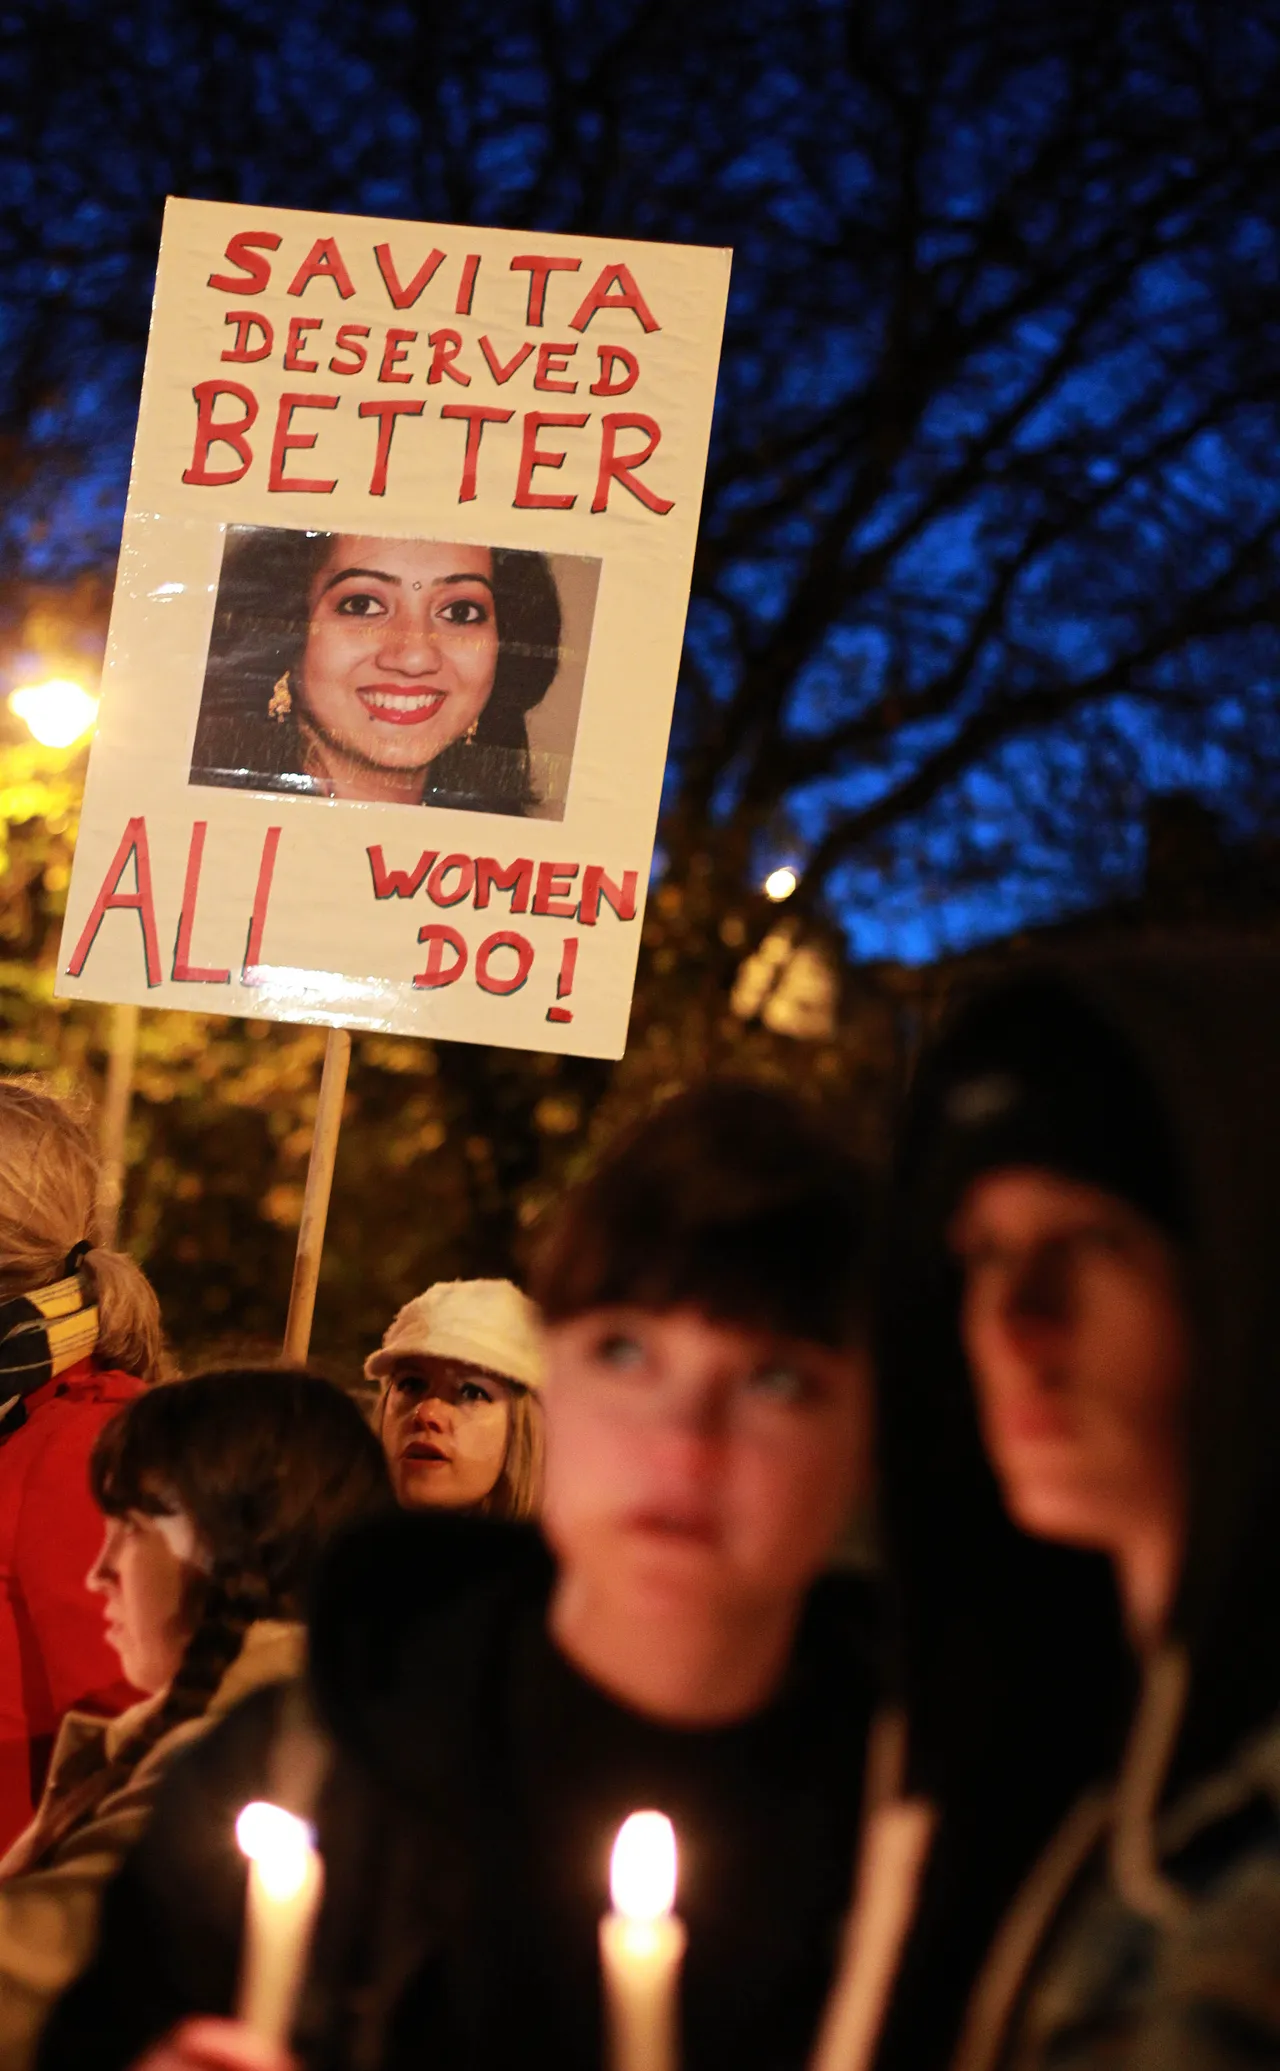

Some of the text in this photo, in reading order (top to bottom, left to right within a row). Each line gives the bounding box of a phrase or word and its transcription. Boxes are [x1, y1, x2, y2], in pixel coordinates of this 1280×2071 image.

[207, 230, 661, 334] SAVITA
[220, 310, 641, 397] DESERVED
[182, 378, 676, 515] BETTER
[366, 843, 639, 926] WOMEN
[413, 922, 579, 1023] DO!
